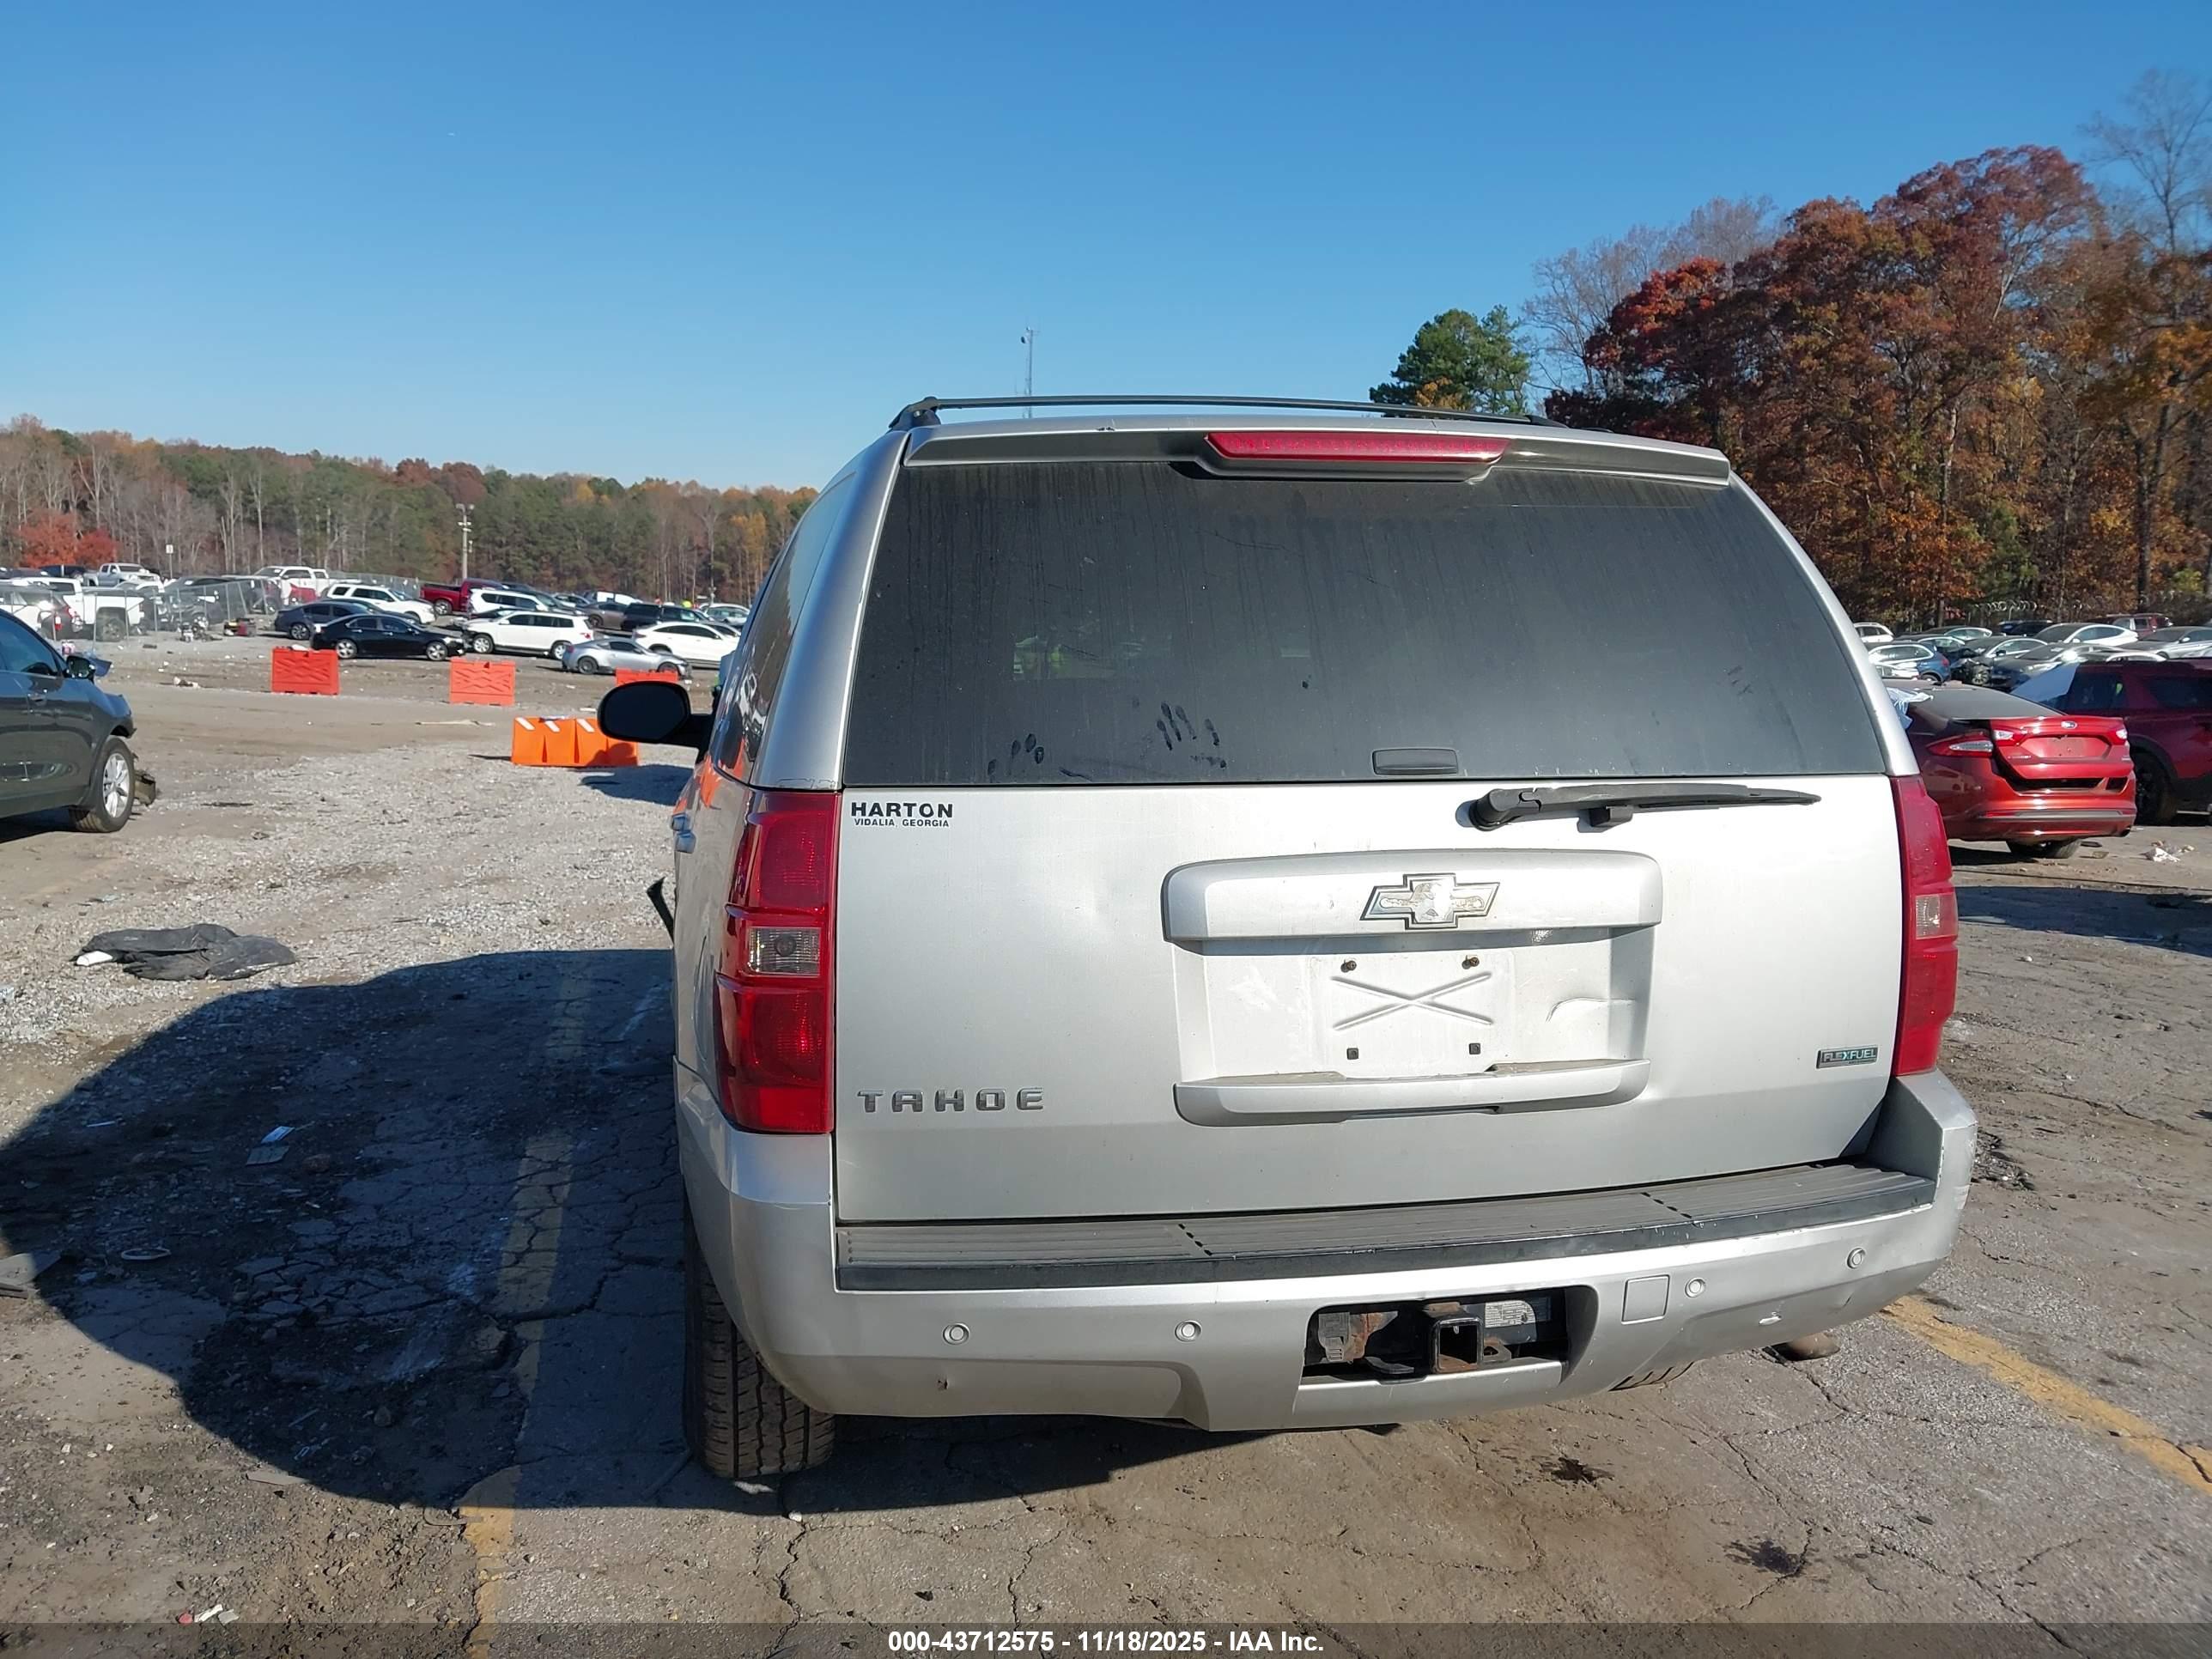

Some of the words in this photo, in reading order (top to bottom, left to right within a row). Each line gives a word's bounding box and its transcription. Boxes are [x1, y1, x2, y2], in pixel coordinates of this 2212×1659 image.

[851, 802, 953, 818] HARTON
[902, 818, 950, 827] GEORGIA
[857, 1087, 1044, 1113] TAHOE
